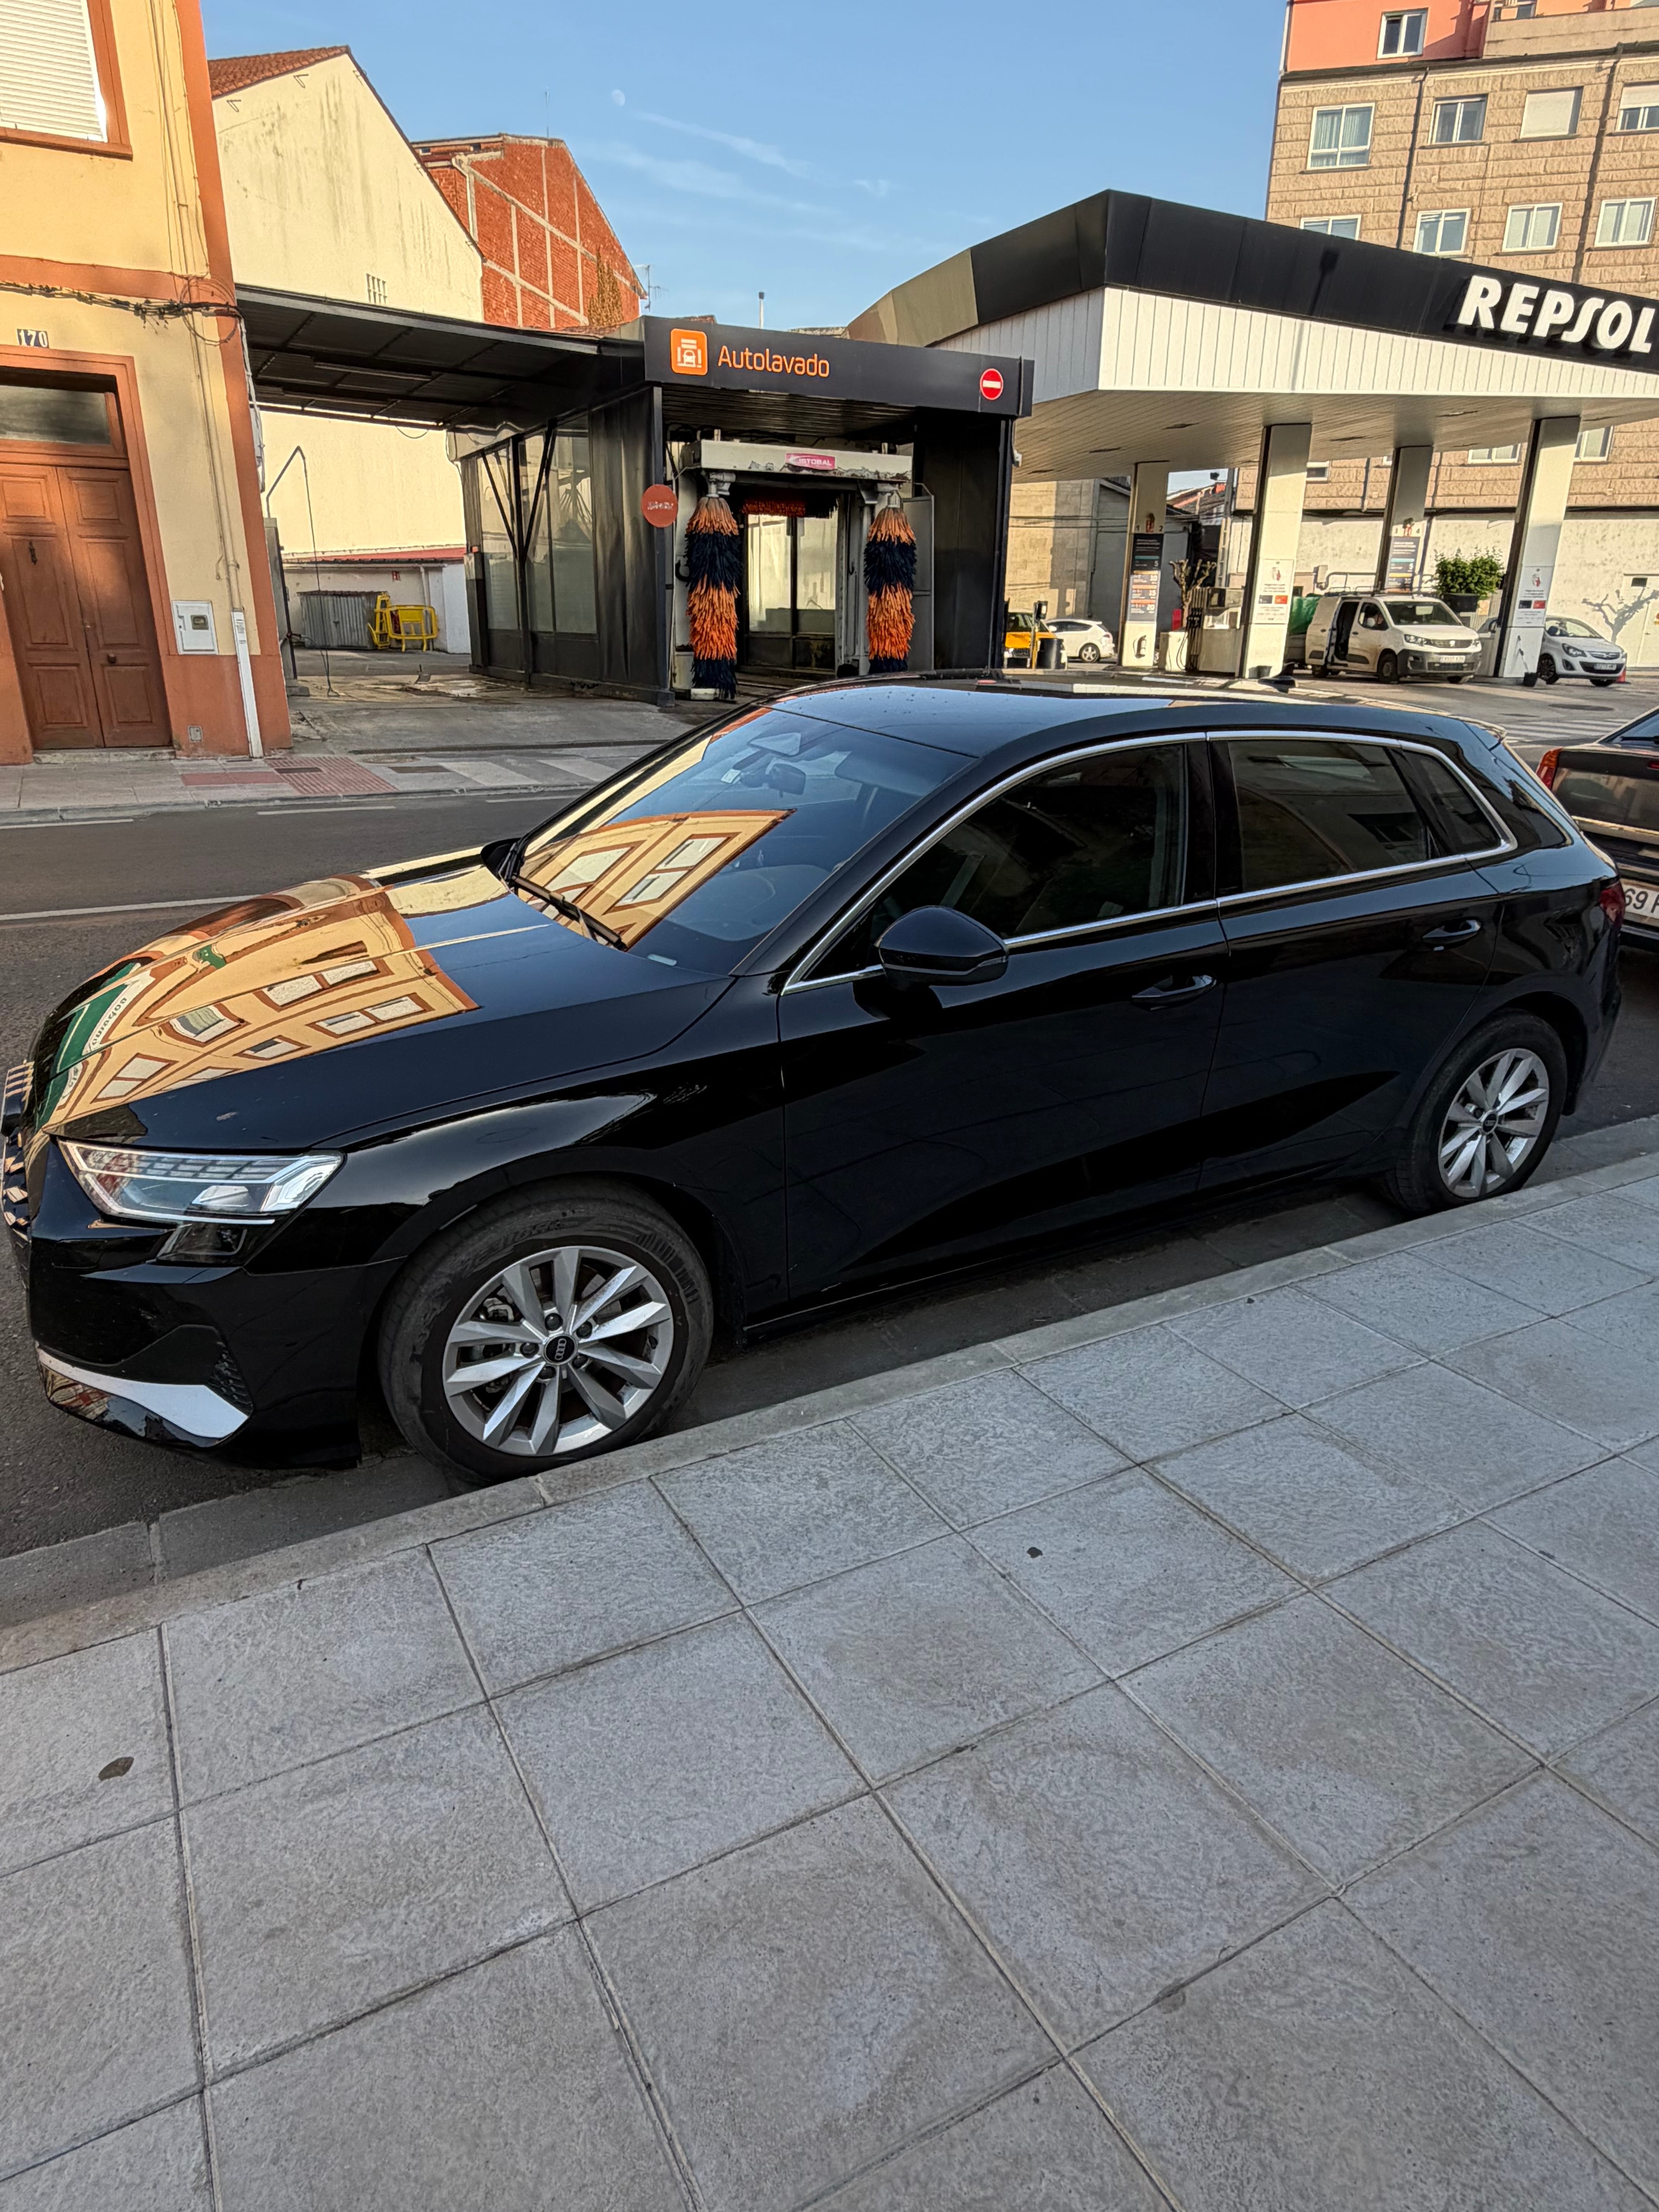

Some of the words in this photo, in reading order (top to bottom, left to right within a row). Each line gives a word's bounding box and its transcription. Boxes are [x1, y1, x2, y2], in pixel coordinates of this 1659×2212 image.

[1458, 275, 1655, 353] REPSOL
[19, 330, 48, 347] 170
[718, 345, 830, 378] Autolavado
